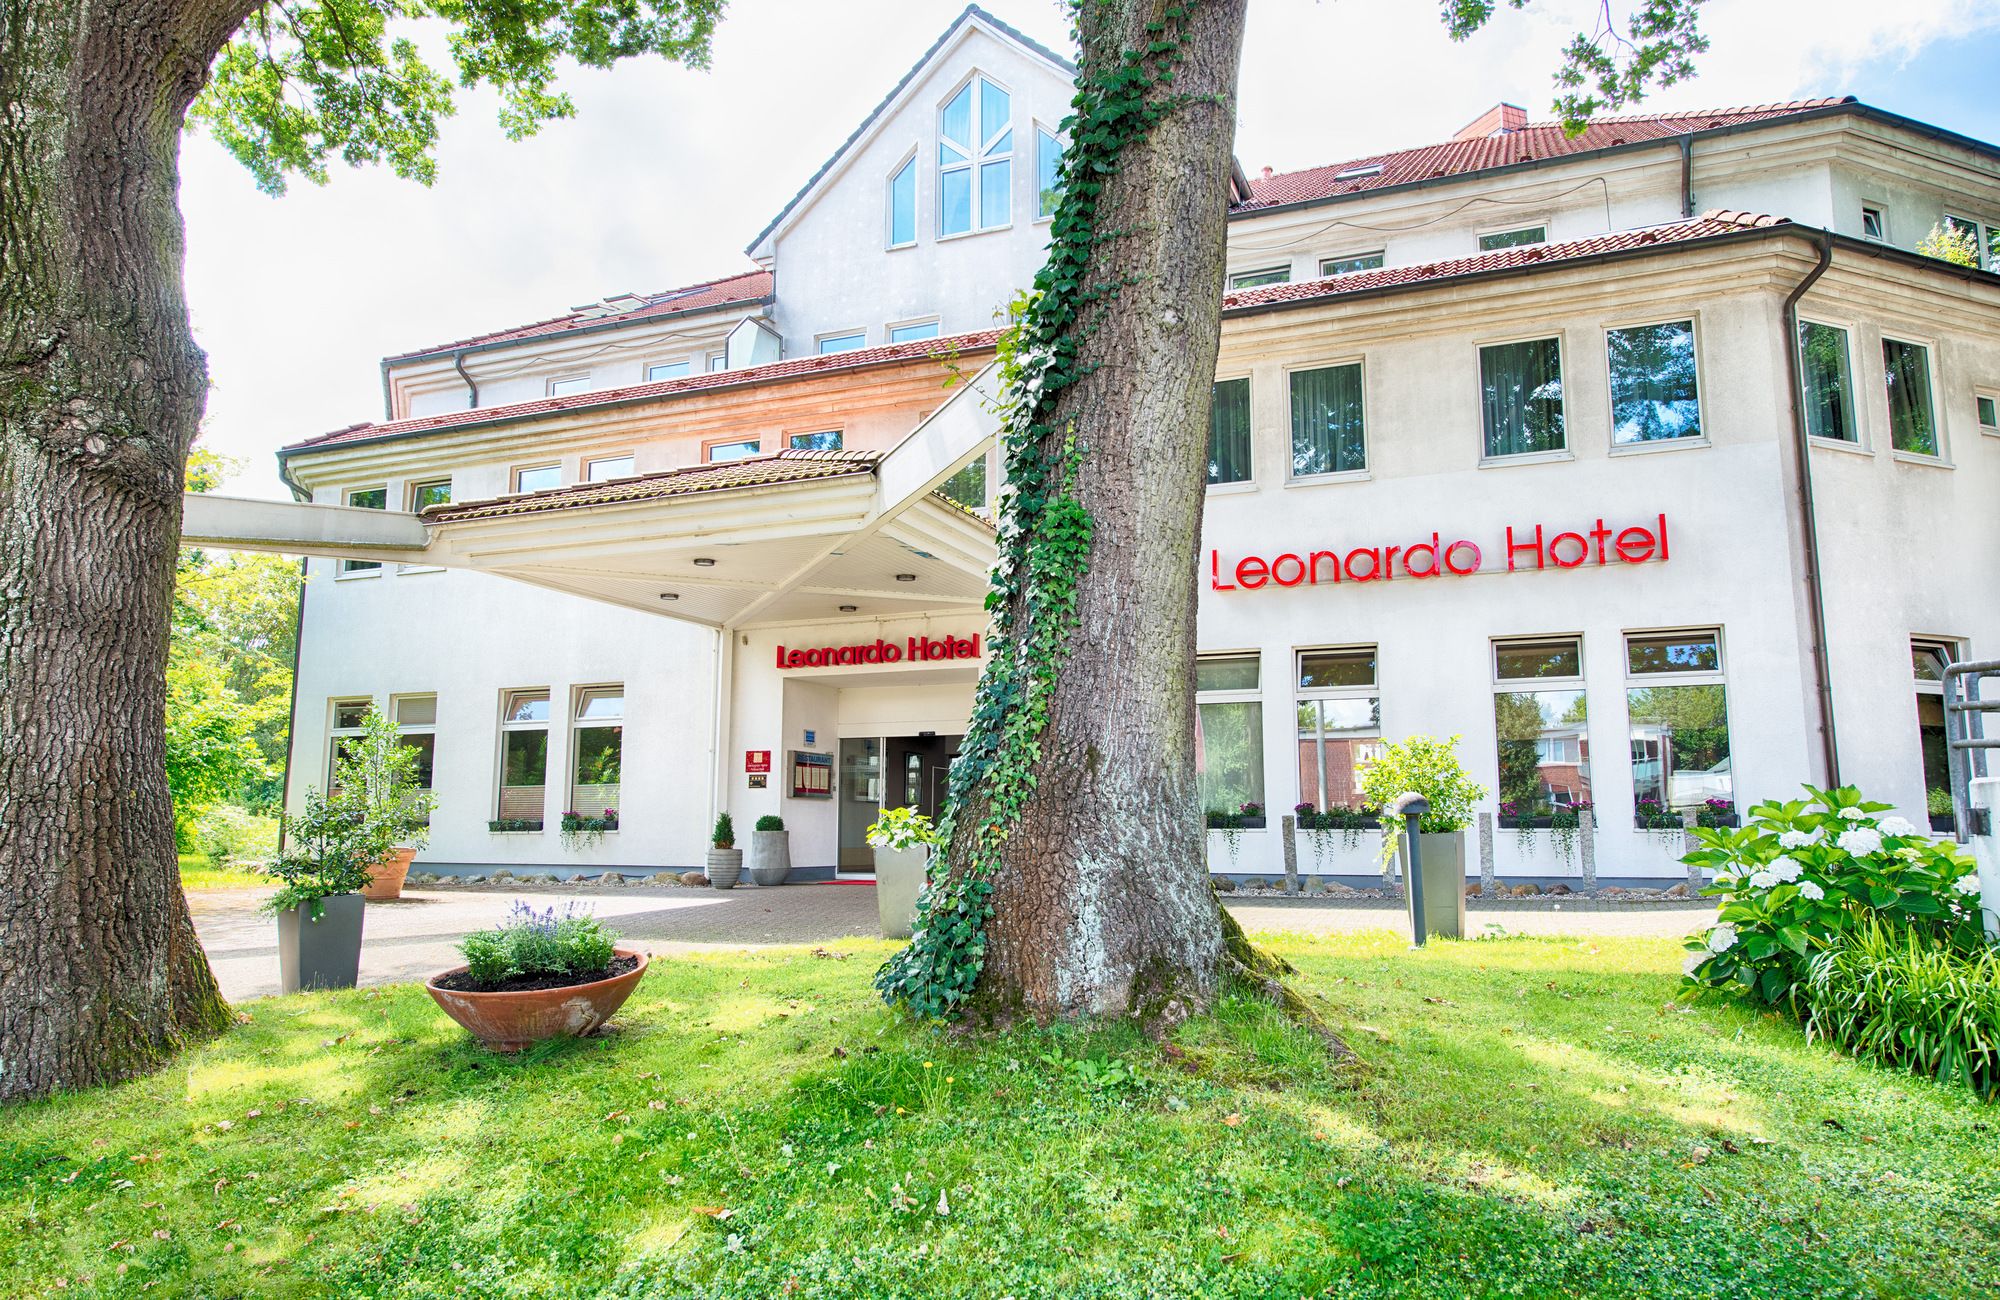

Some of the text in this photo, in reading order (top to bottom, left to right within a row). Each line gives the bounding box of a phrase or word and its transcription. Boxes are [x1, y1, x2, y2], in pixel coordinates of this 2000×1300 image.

[1212, 513, 1669, 591] Leonardo Hotel
[777, 633, 981, 668] Leonardo Hotel
